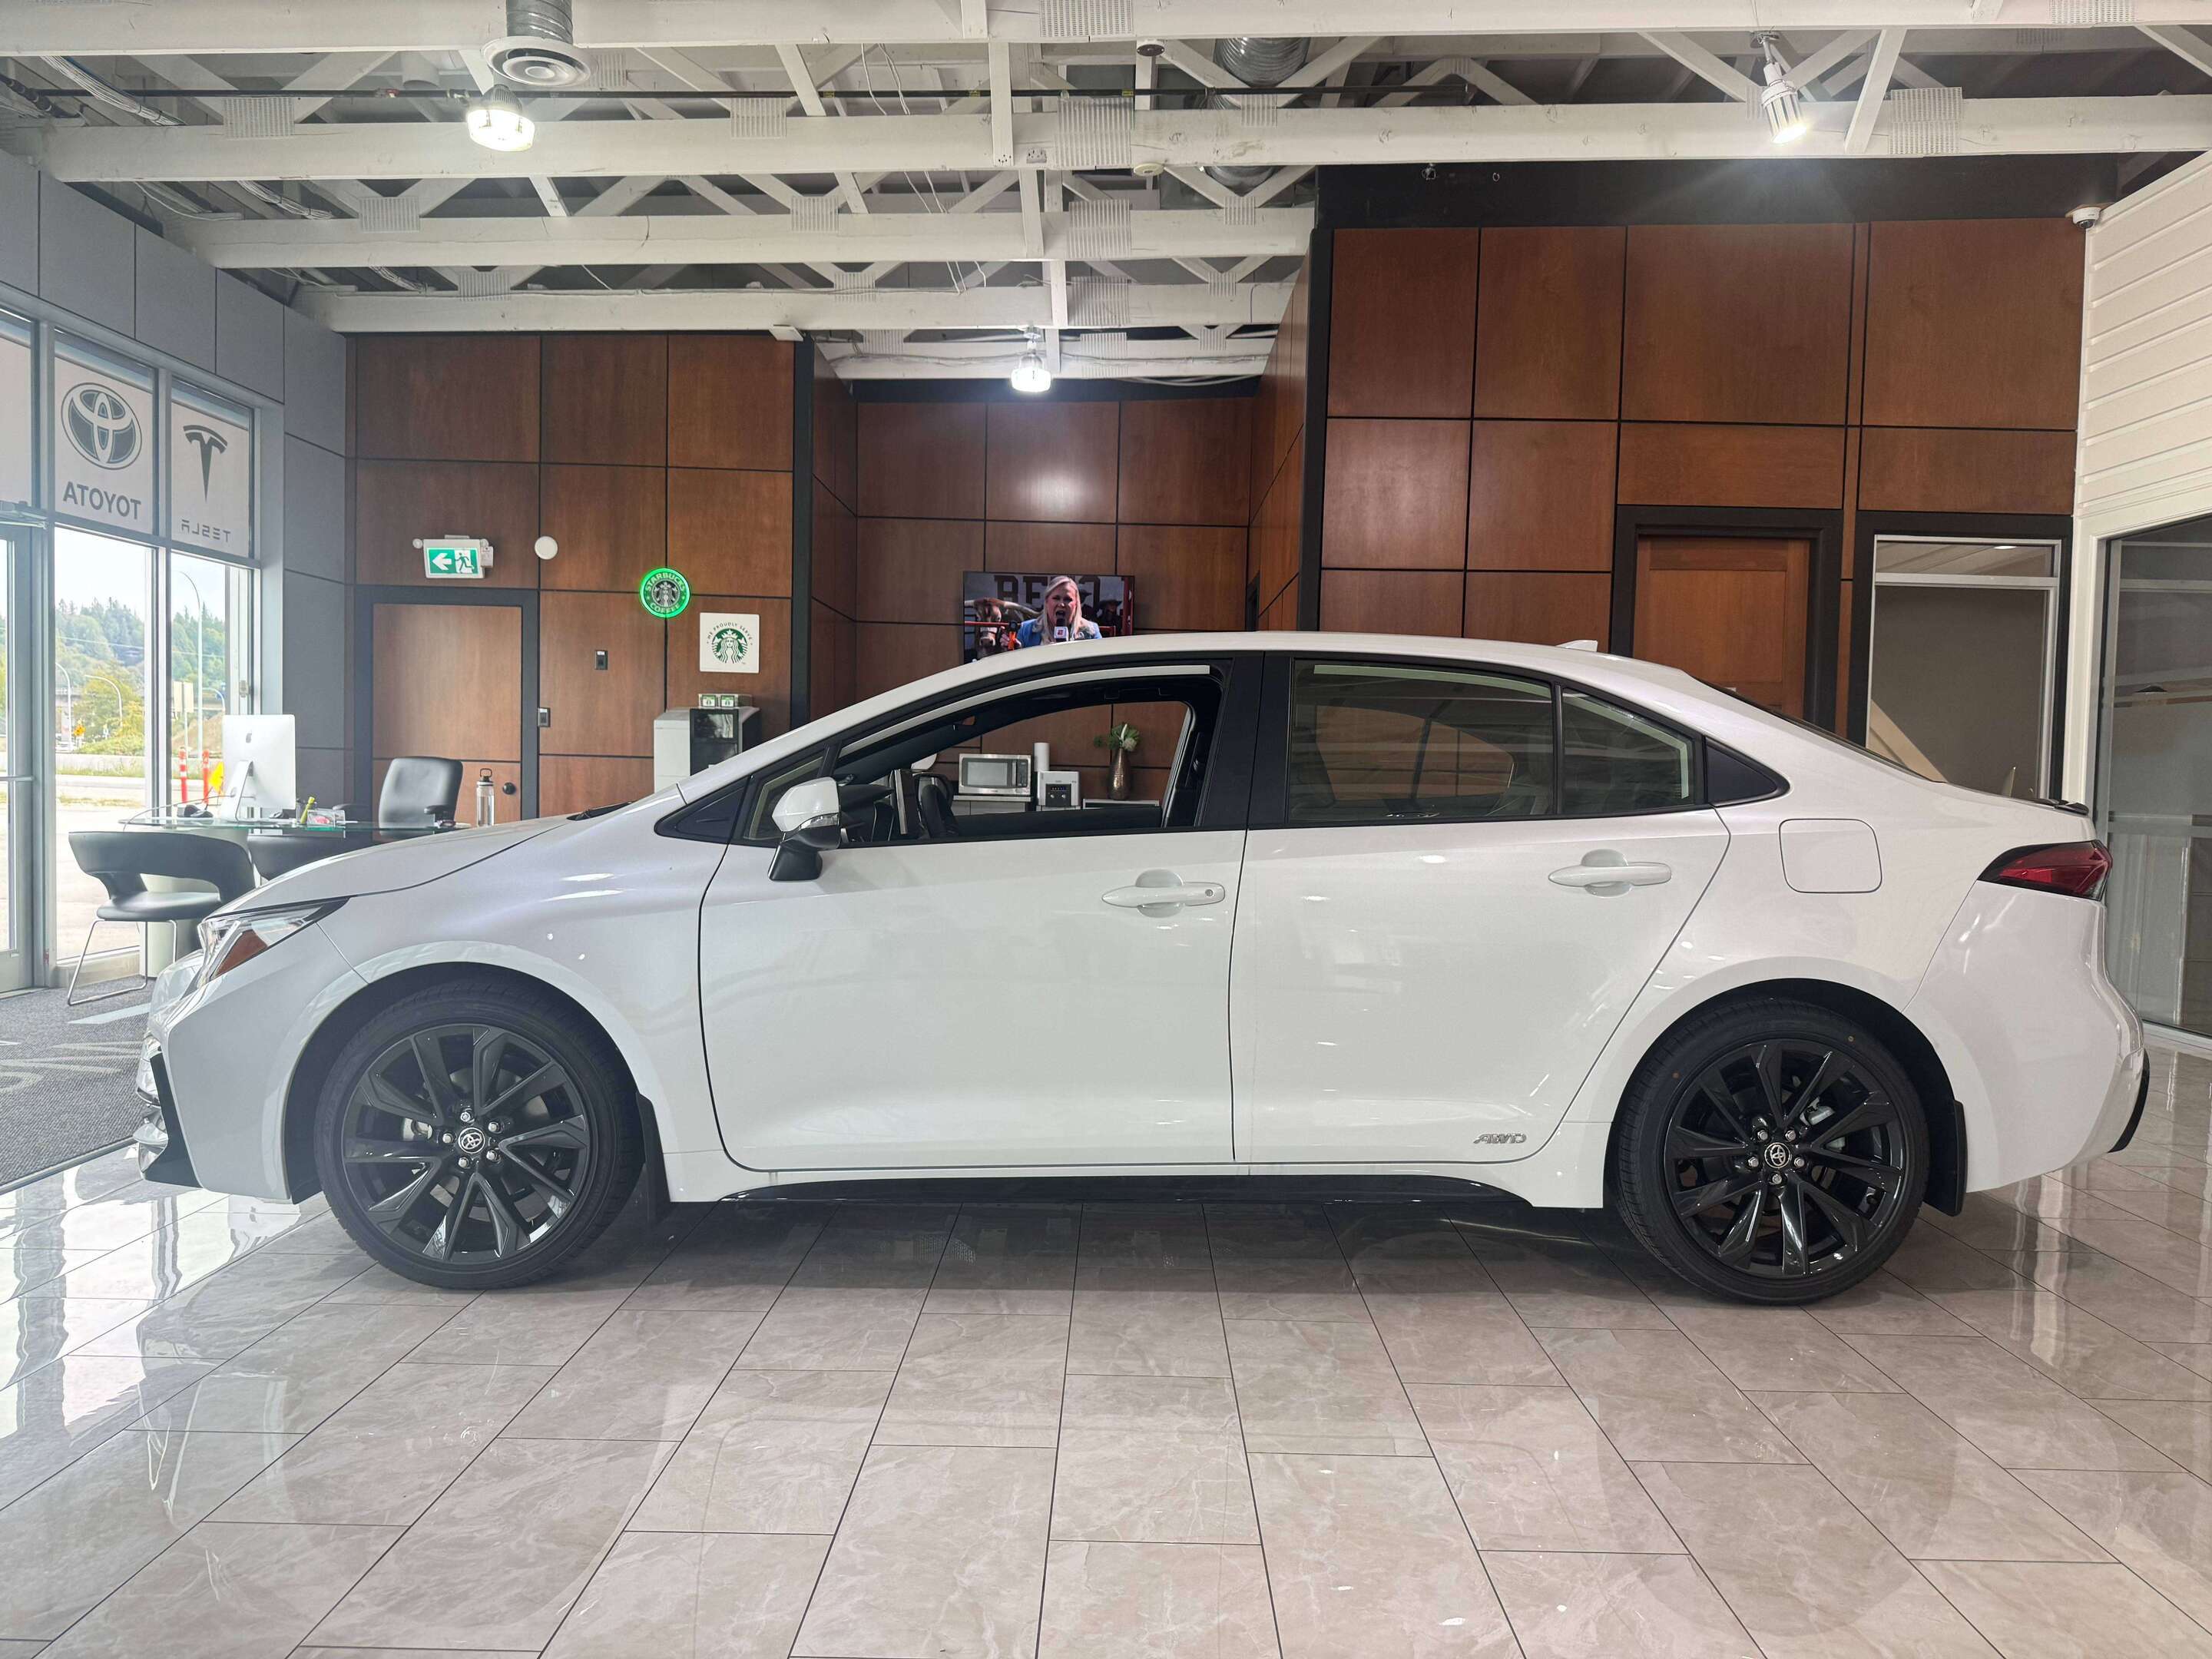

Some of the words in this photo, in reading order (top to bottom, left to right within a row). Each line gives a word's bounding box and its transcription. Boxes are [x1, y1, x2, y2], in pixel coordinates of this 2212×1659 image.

[645, 572, 685, 591] STARBUCKS
[650, 602, 680, 614] COFFEE
[713, 622, 737, 631] PROUDLY
[740, 625, 753, 640] SERVE
[1472, 1133, 1527, 1144] AWD
